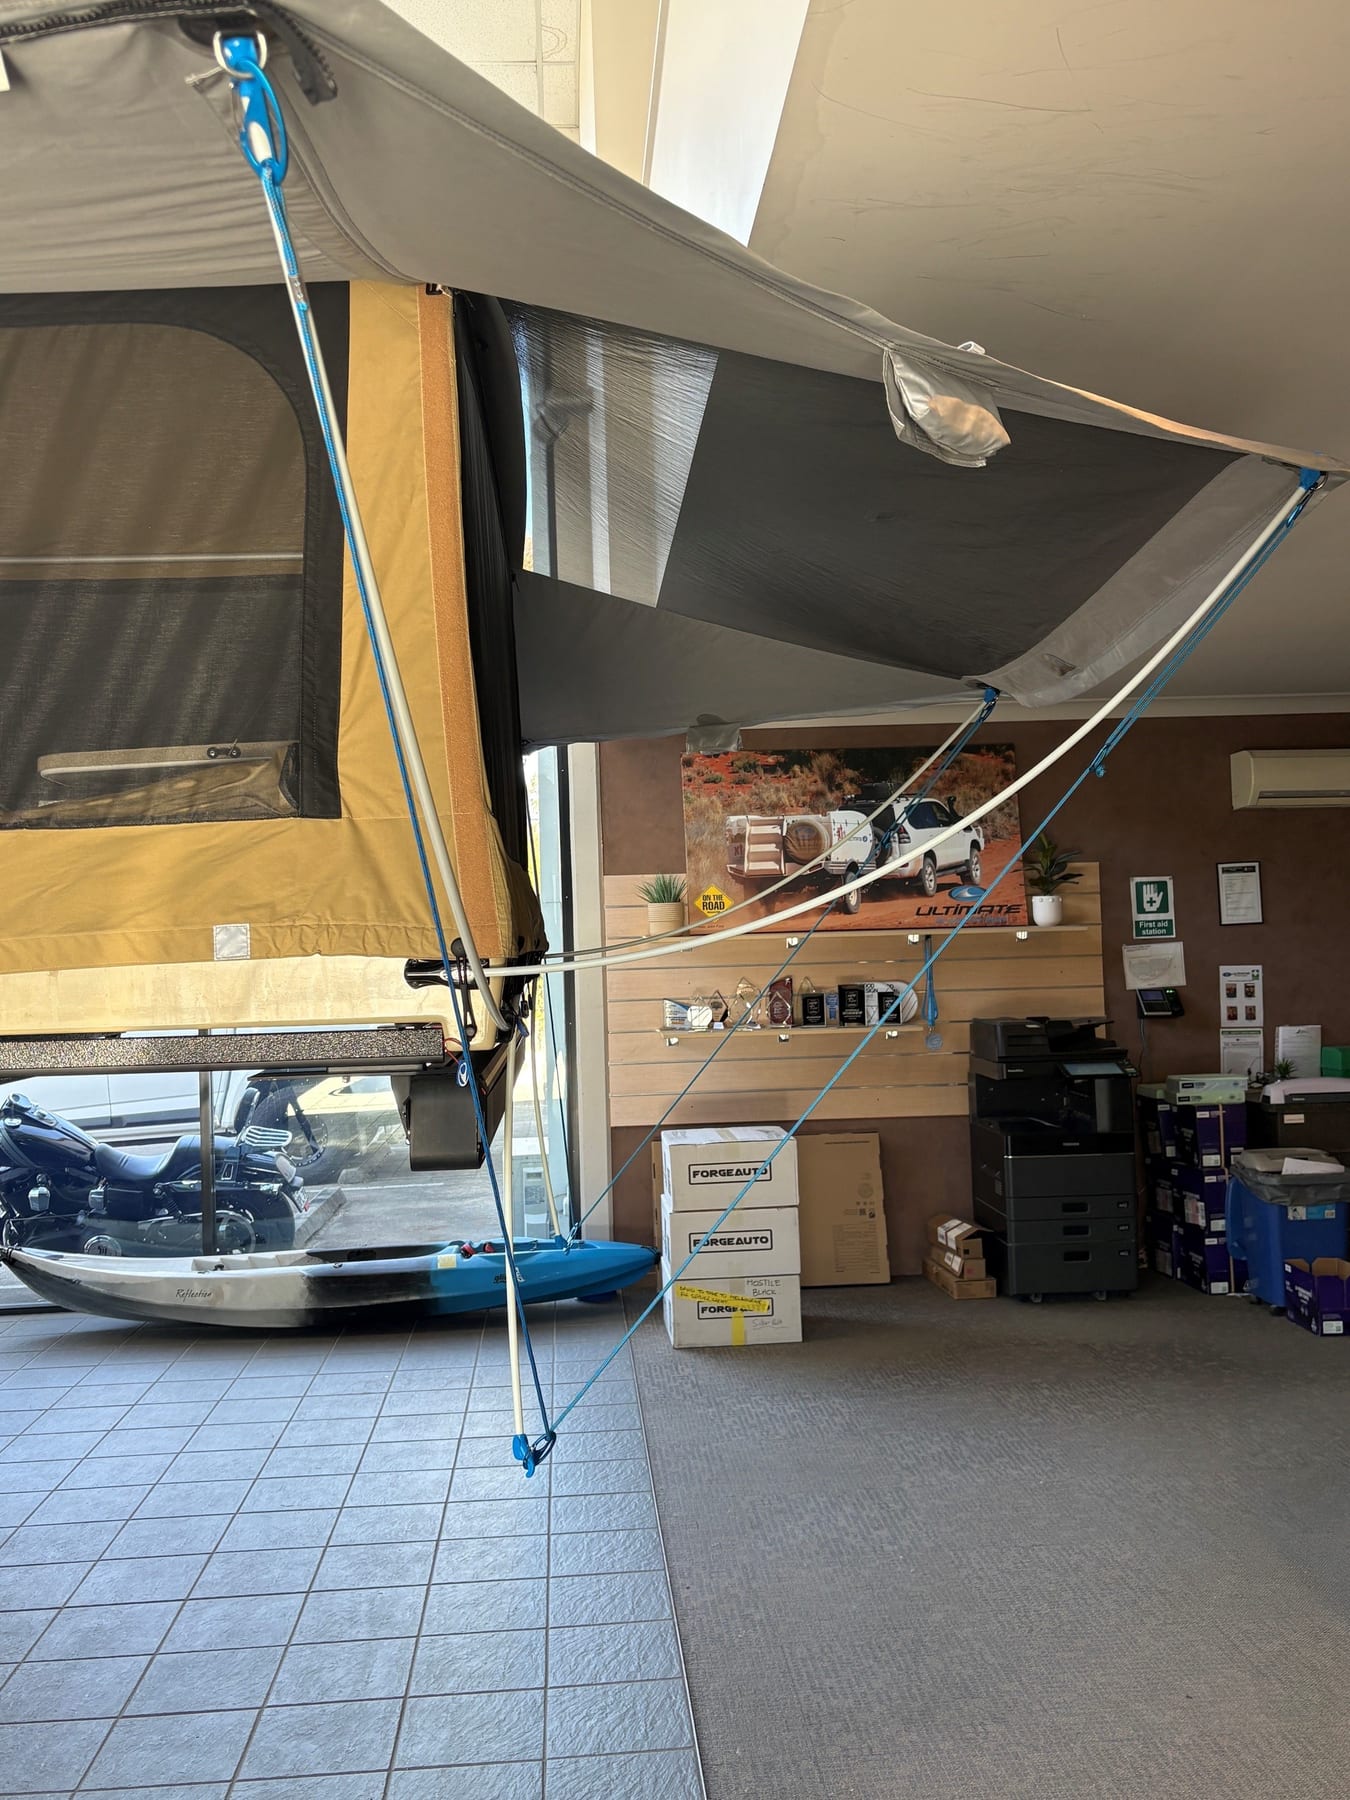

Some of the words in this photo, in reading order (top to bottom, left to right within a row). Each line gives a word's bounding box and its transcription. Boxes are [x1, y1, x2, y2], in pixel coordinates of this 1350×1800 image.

[702, 901, 725, 911] ROAD
[692, 1168, 768, 1178] FORGEAUTO
[693, 1236, 769, 1247] FORGEAUTO
[746, 1278, 782, 1287] HOSTILE
[175, 1288, 212, 1303] Reflection
[752, 1288, 777, 1297] BLACK
